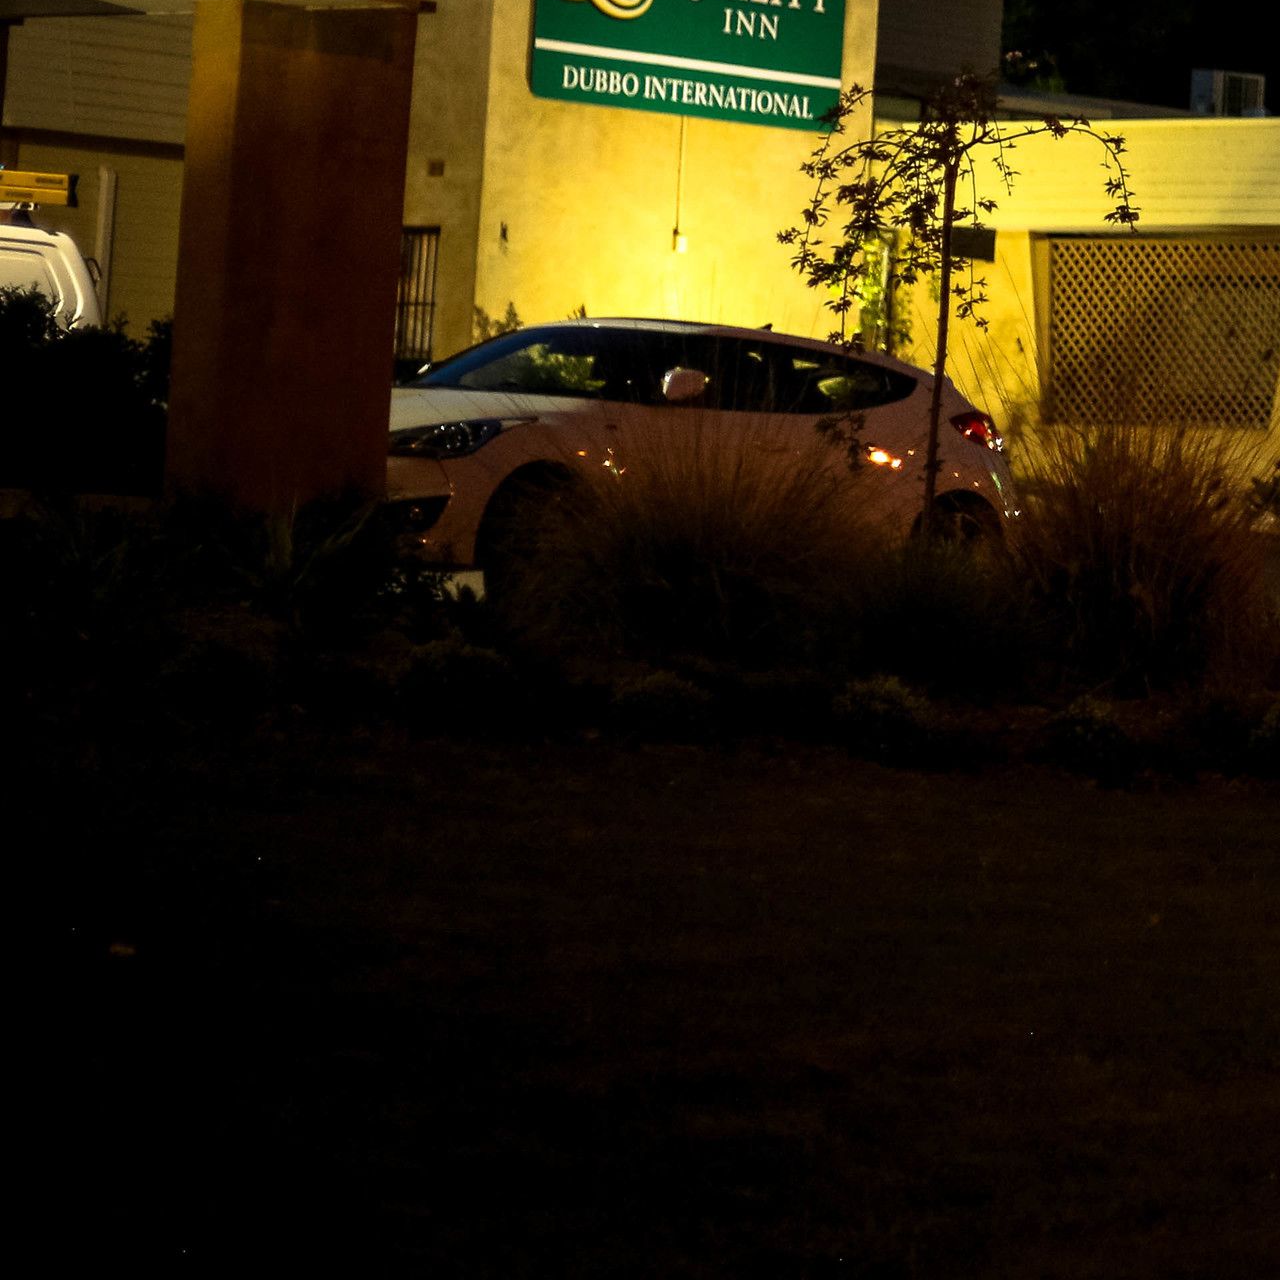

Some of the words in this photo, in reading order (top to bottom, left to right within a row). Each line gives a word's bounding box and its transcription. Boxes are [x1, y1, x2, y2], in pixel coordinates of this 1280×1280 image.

[722, 7, 780, 41] INN
[562, 64, 640, 98] DUBBO
[643, 75, 814, 120] INTERNATIONAL
